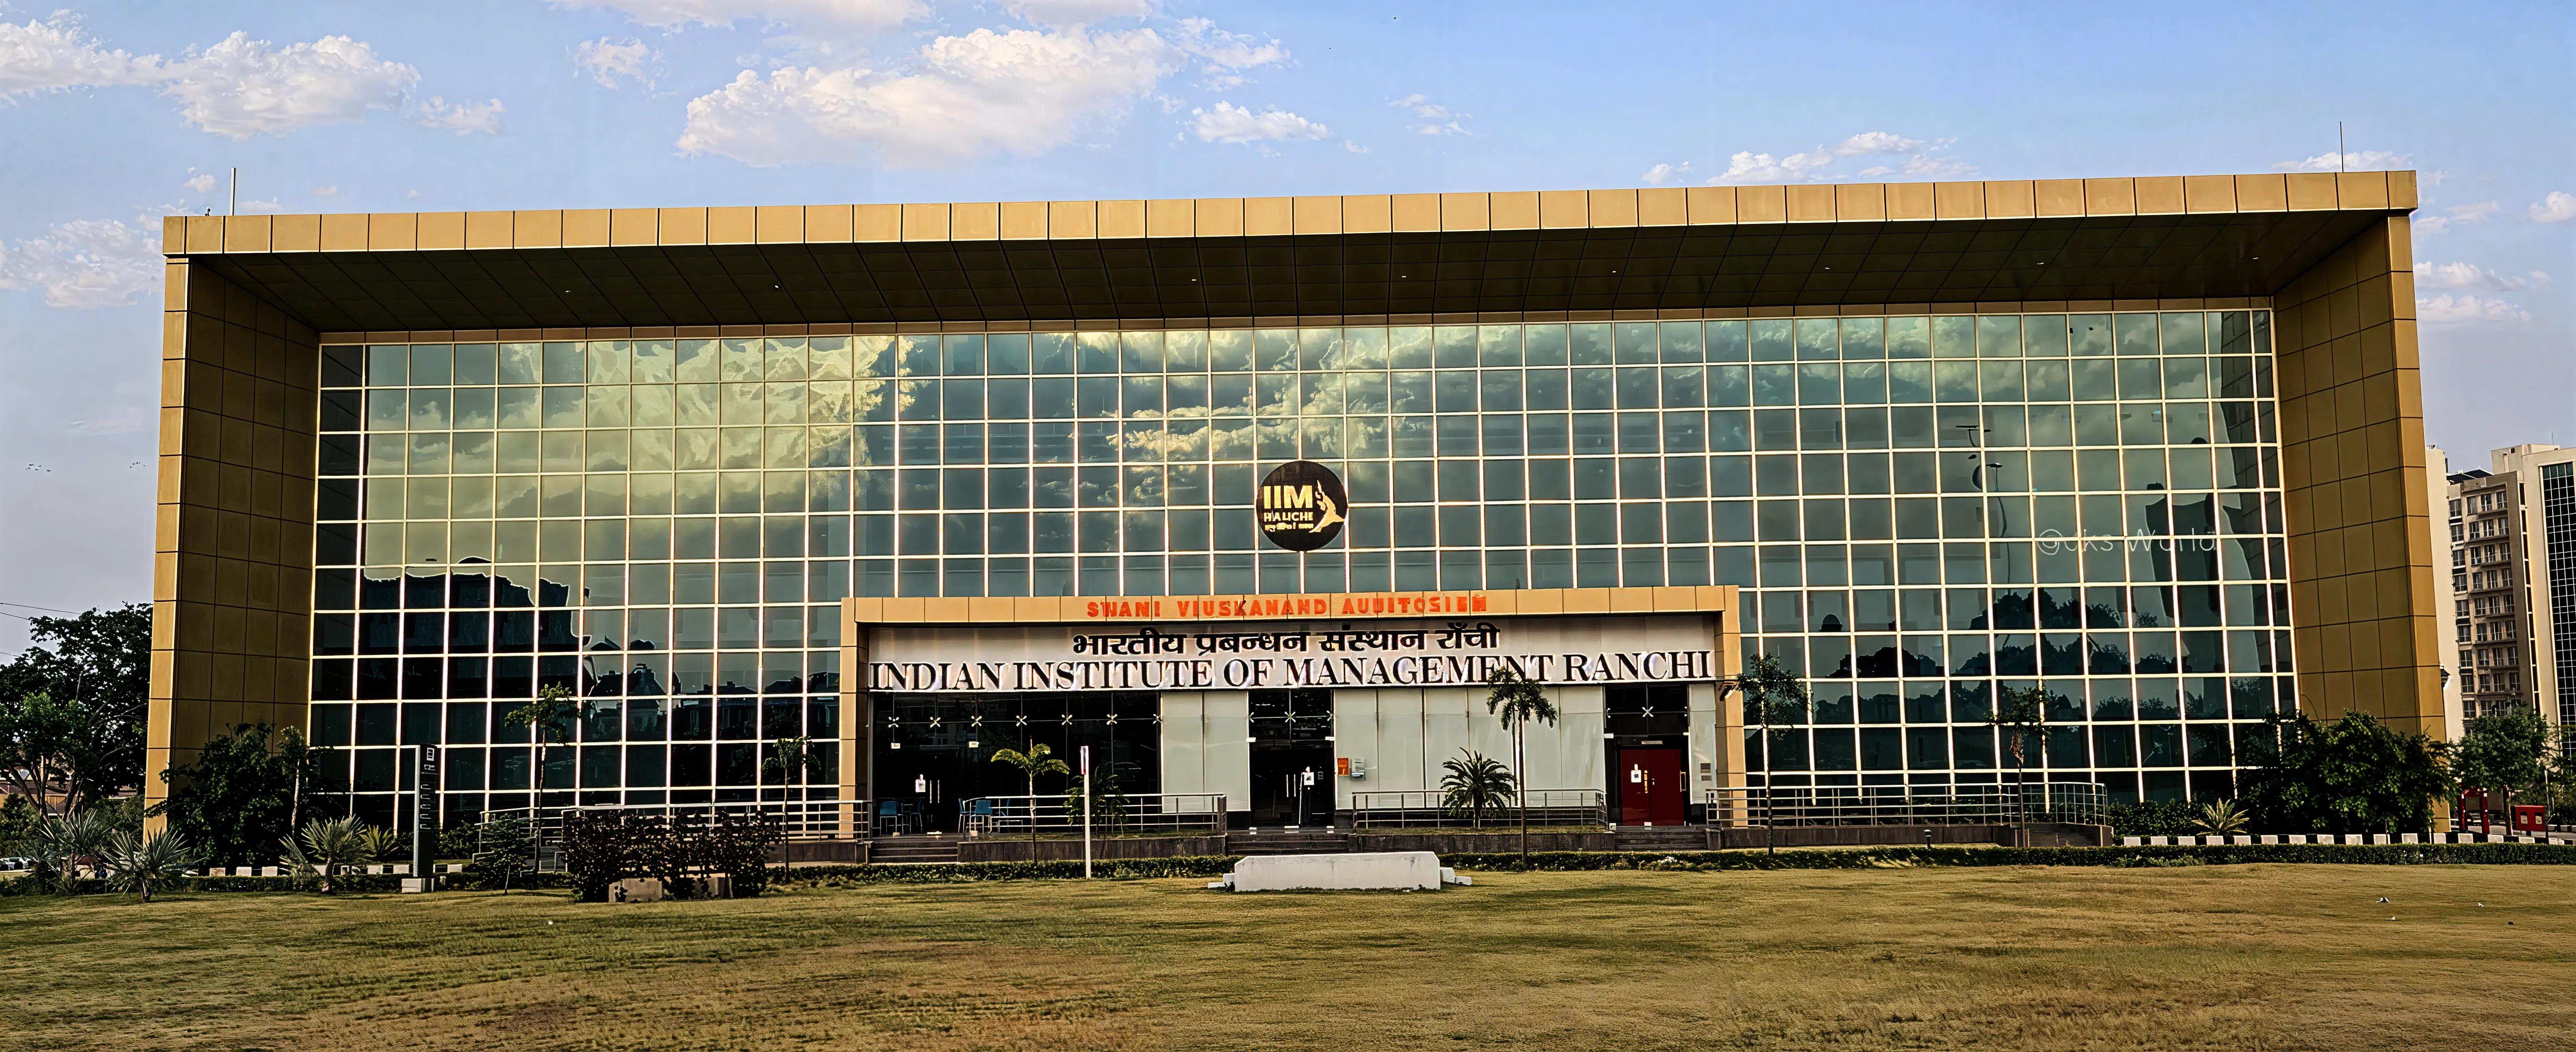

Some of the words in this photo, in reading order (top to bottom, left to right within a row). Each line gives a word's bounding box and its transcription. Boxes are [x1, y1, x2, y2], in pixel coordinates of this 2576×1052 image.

[1264, 485, 1313, 509] IIM
[1073, 627, 1187, 655] भारतीय
[1193, 631, 1311, 656] प्रबन्धन
[1319, 624, 1429, 651] संस्थान
[1435, 622, 1501, 649] राँची
[869, 662, 1006, 690] INDIAN
[1013, 660, 1213, 690] INSTITUTE
[1223, 659, 1274, 687] OF
[1283, 654, 1554, 686] MANAGEMENT
[1562, 651, 1713, 681] RANCHI
